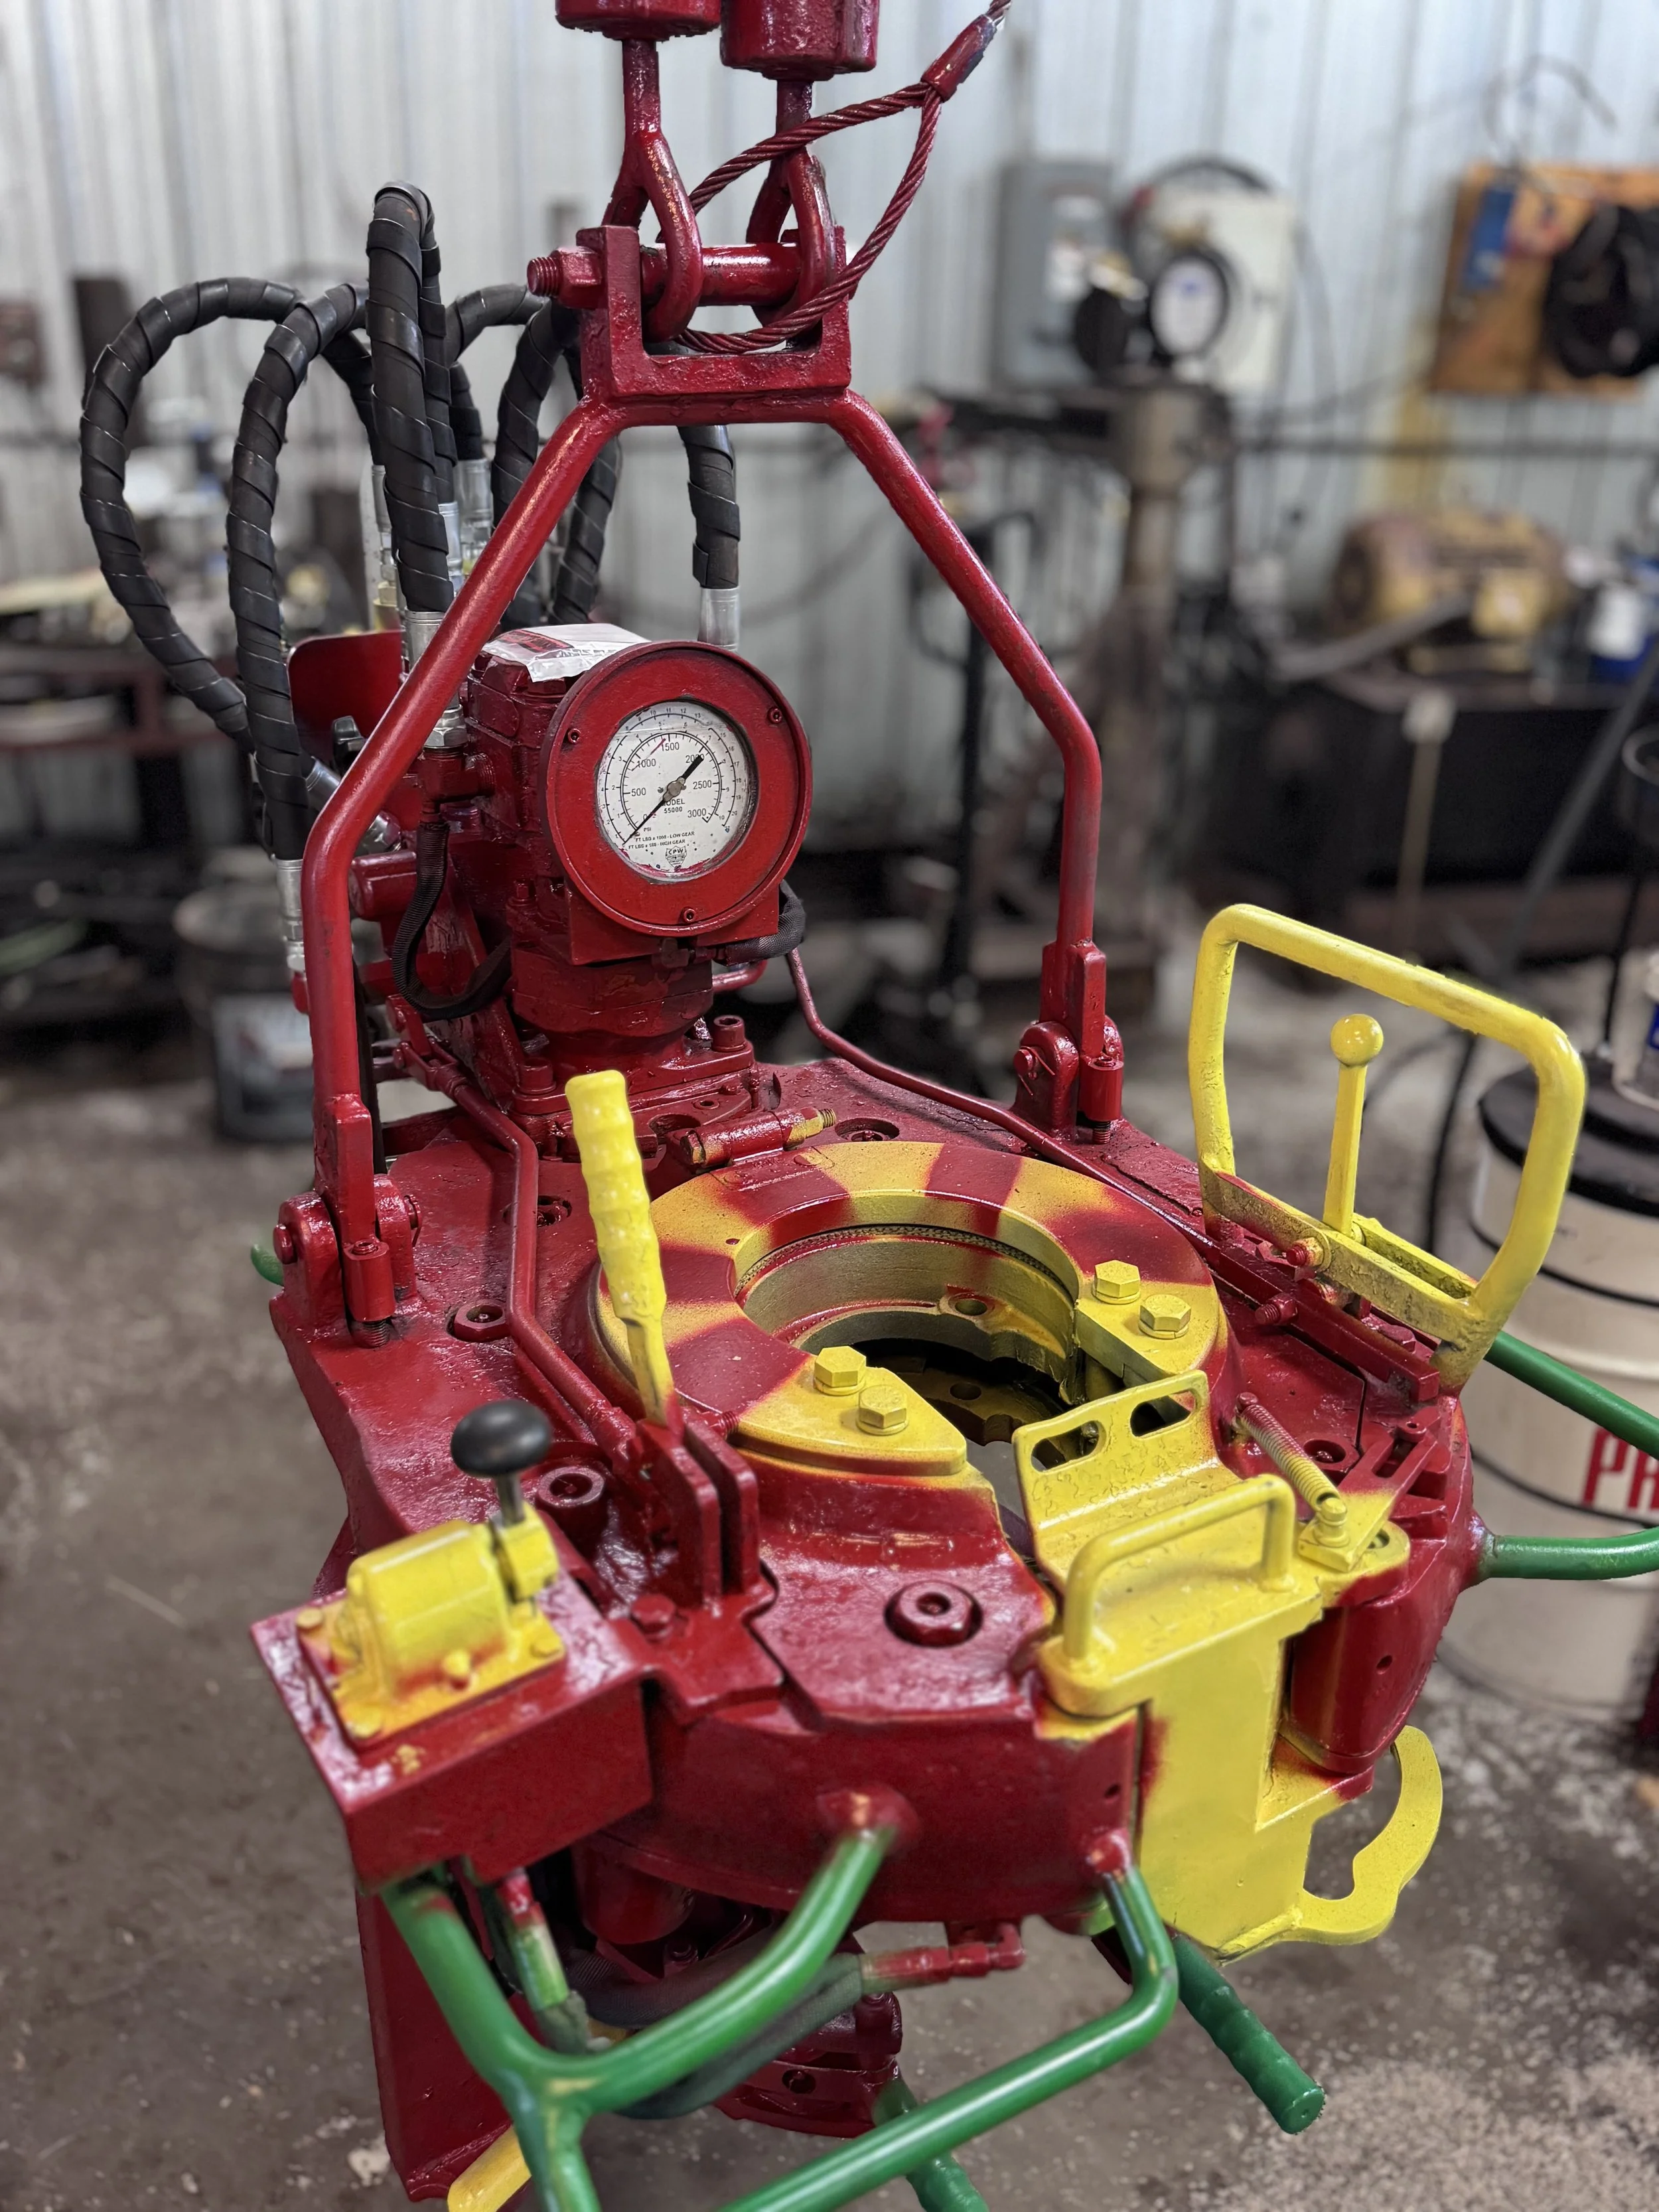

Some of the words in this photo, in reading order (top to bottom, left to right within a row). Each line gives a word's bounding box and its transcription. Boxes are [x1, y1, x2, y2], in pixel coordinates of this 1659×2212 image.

[662, 742, 680, 751] 1500
[637, 759, 656, 768] 1000
[693, 780, 712, 790] 2500
[631, 787, 646, 797] 500
[687, 808, 707, 818] 3000
